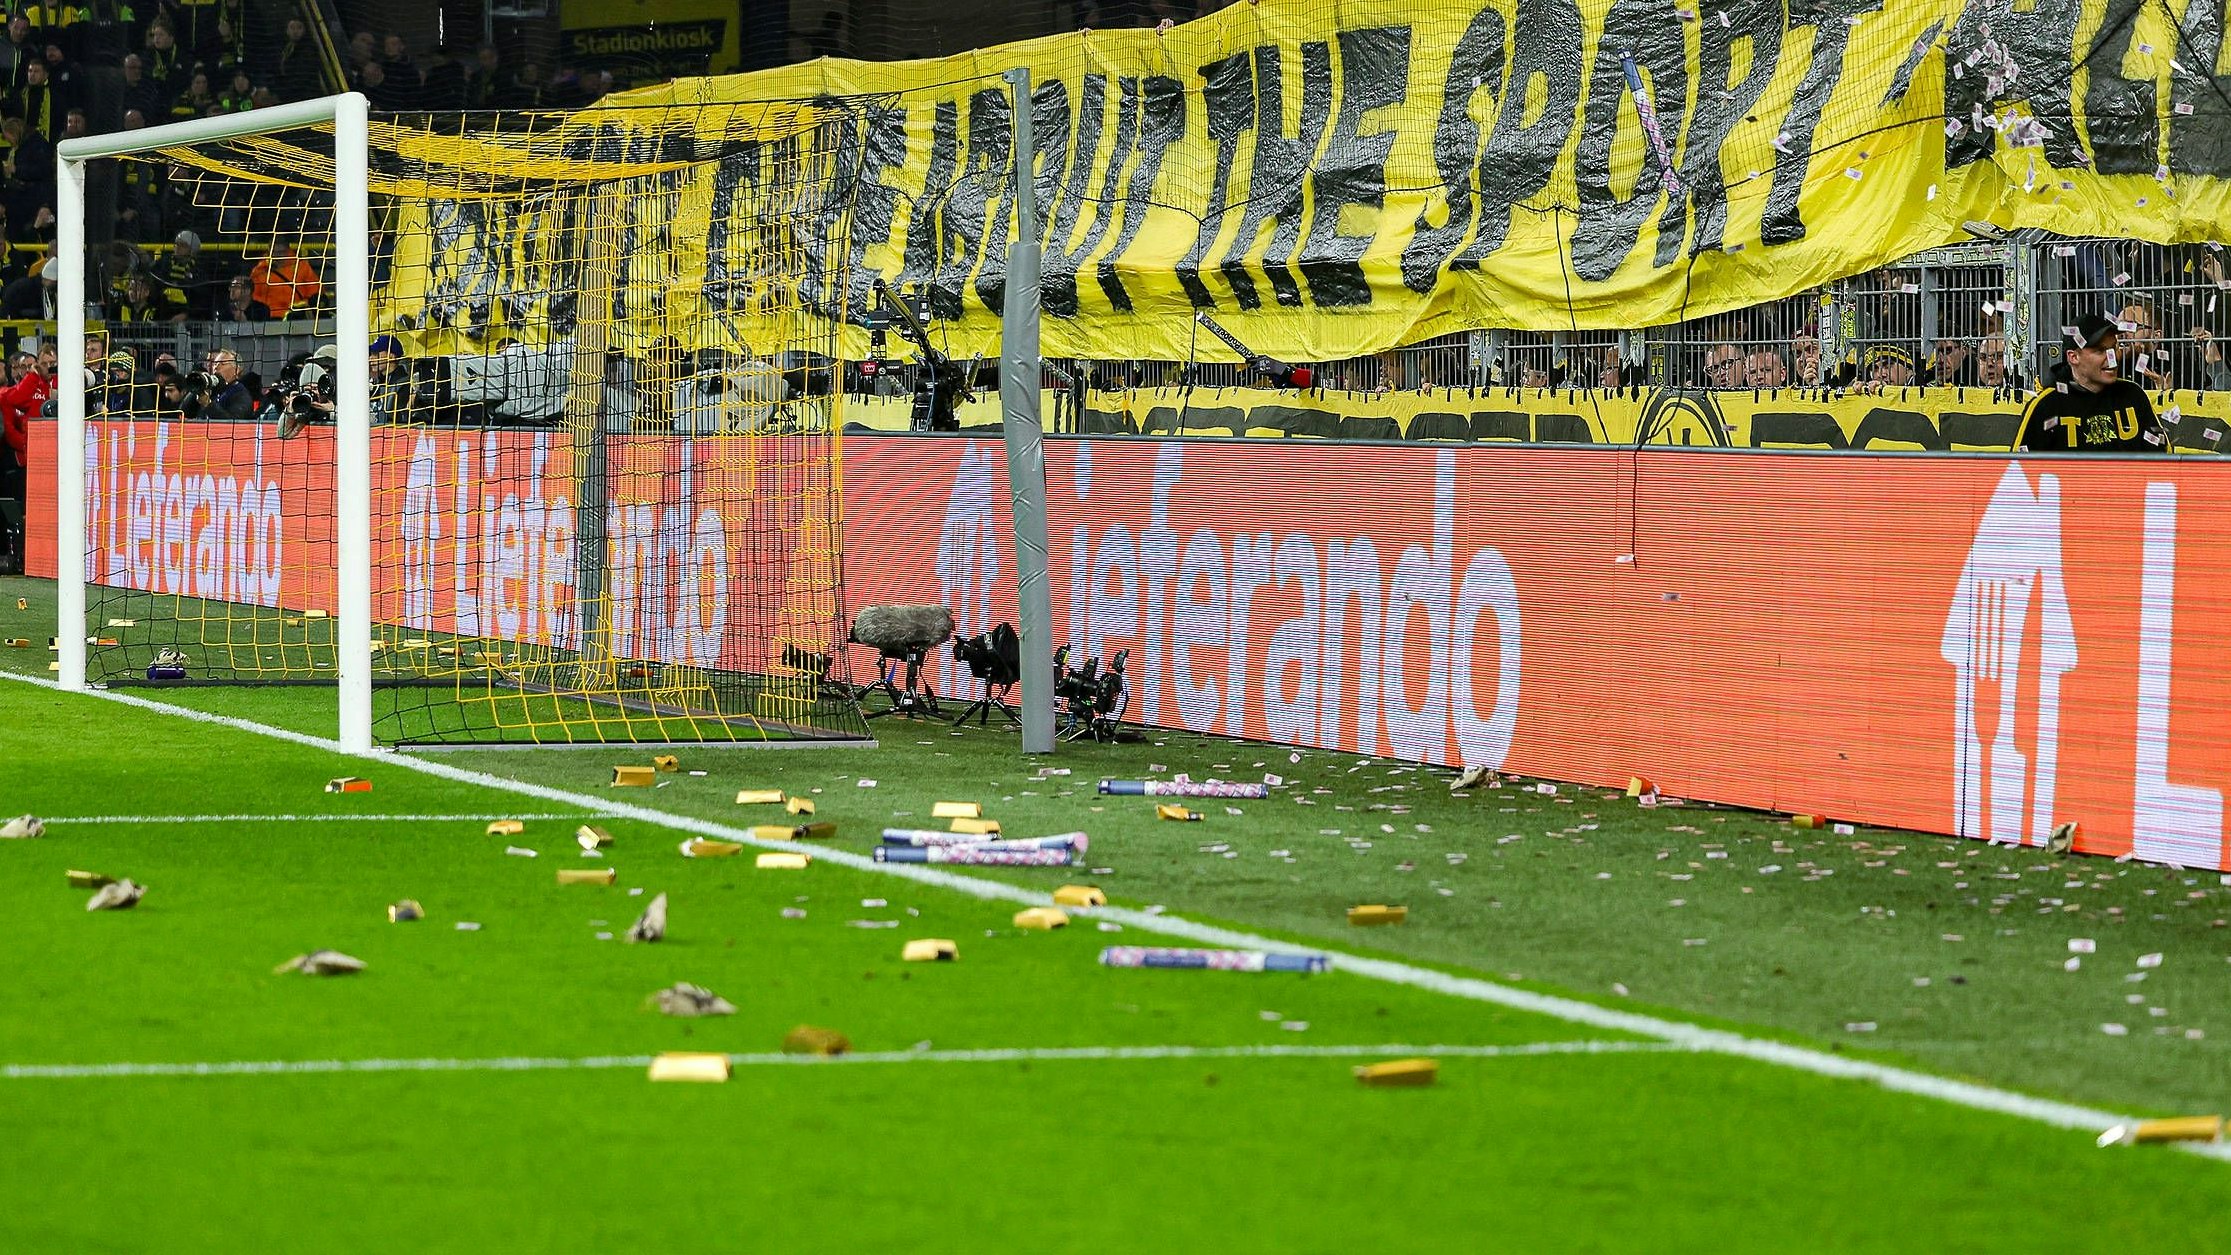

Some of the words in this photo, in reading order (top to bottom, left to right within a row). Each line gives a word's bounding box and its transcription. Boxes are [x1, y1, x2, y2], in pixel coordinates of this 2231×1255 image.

[573, 26, 714, 55] Stadionkiosk
[1177, 25, 1412, 310] THE
[1402, 0, 1884, 295] SPORT
[108, 421, 281, 606] Lieferando
[456, 431, 728, 668] Liefeando
[1060, 440, 1521, 769] ieferando
